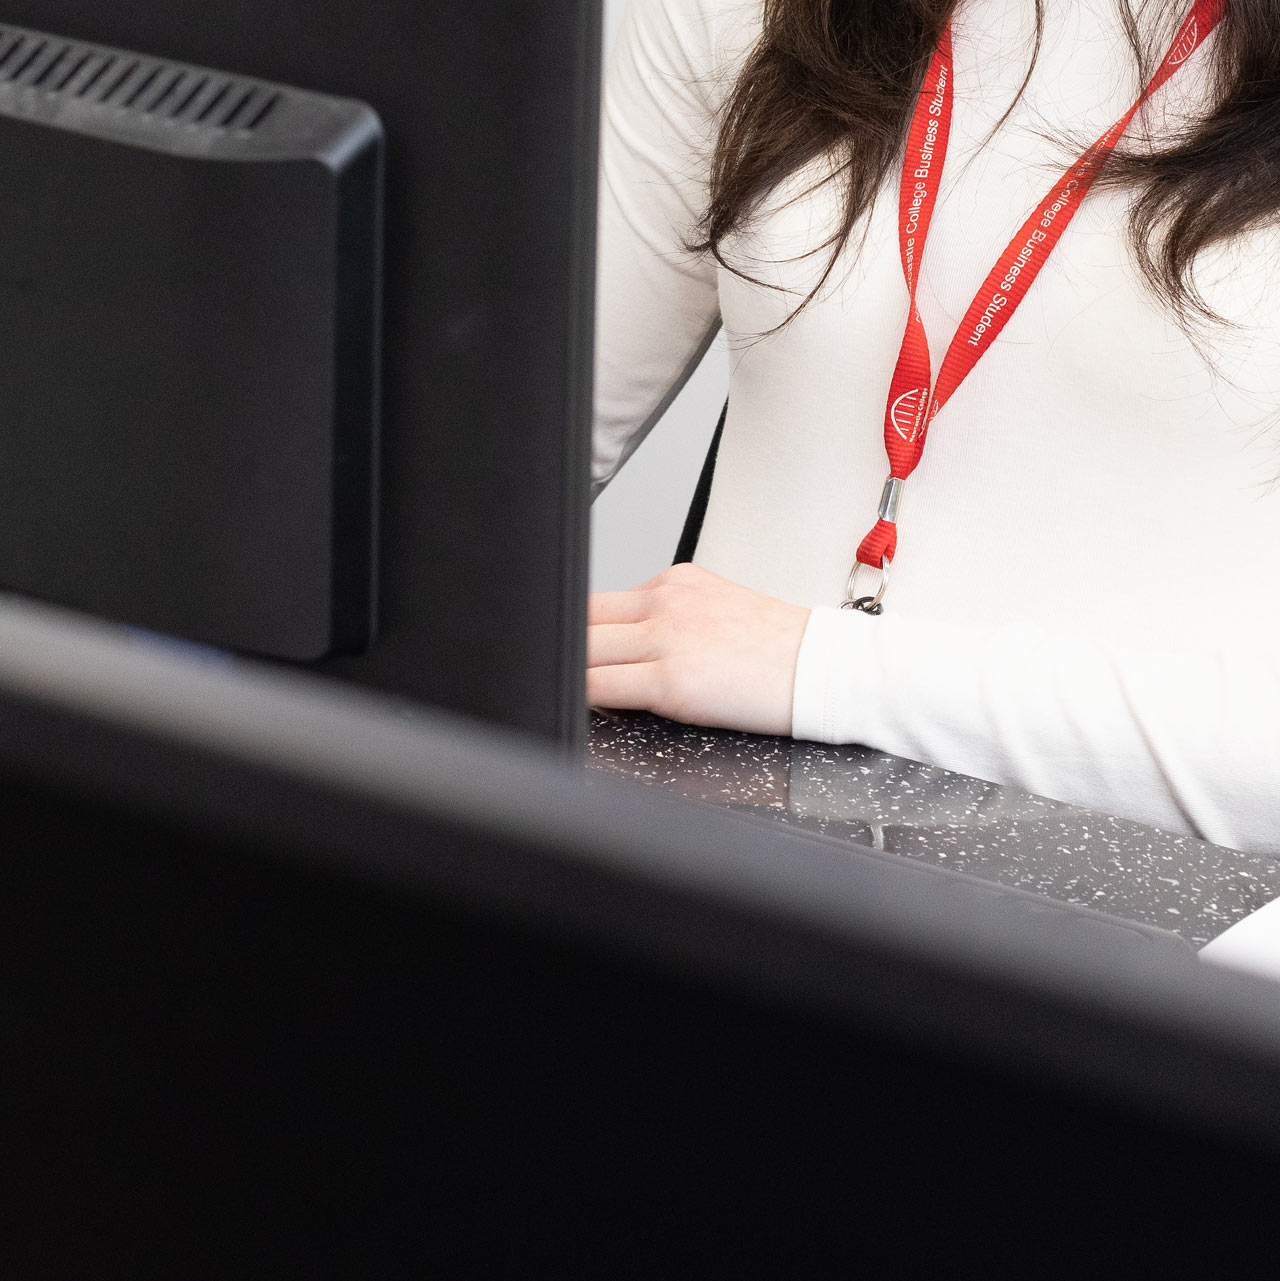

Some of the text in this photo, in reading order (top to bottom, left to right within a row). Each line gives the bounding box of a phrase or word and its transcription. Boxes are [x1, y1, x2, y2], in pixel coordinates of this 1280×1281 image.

[929, 64, 948, 117] Student
[914, 120, 939, 178] Business
[906, 181, 927, 234] College
[1040, 180, 1079, 228] College
[1001, 228, 1047, 291] Business
[967, 293, 1007, 346] Student
[918, 387, 928, 410] College
